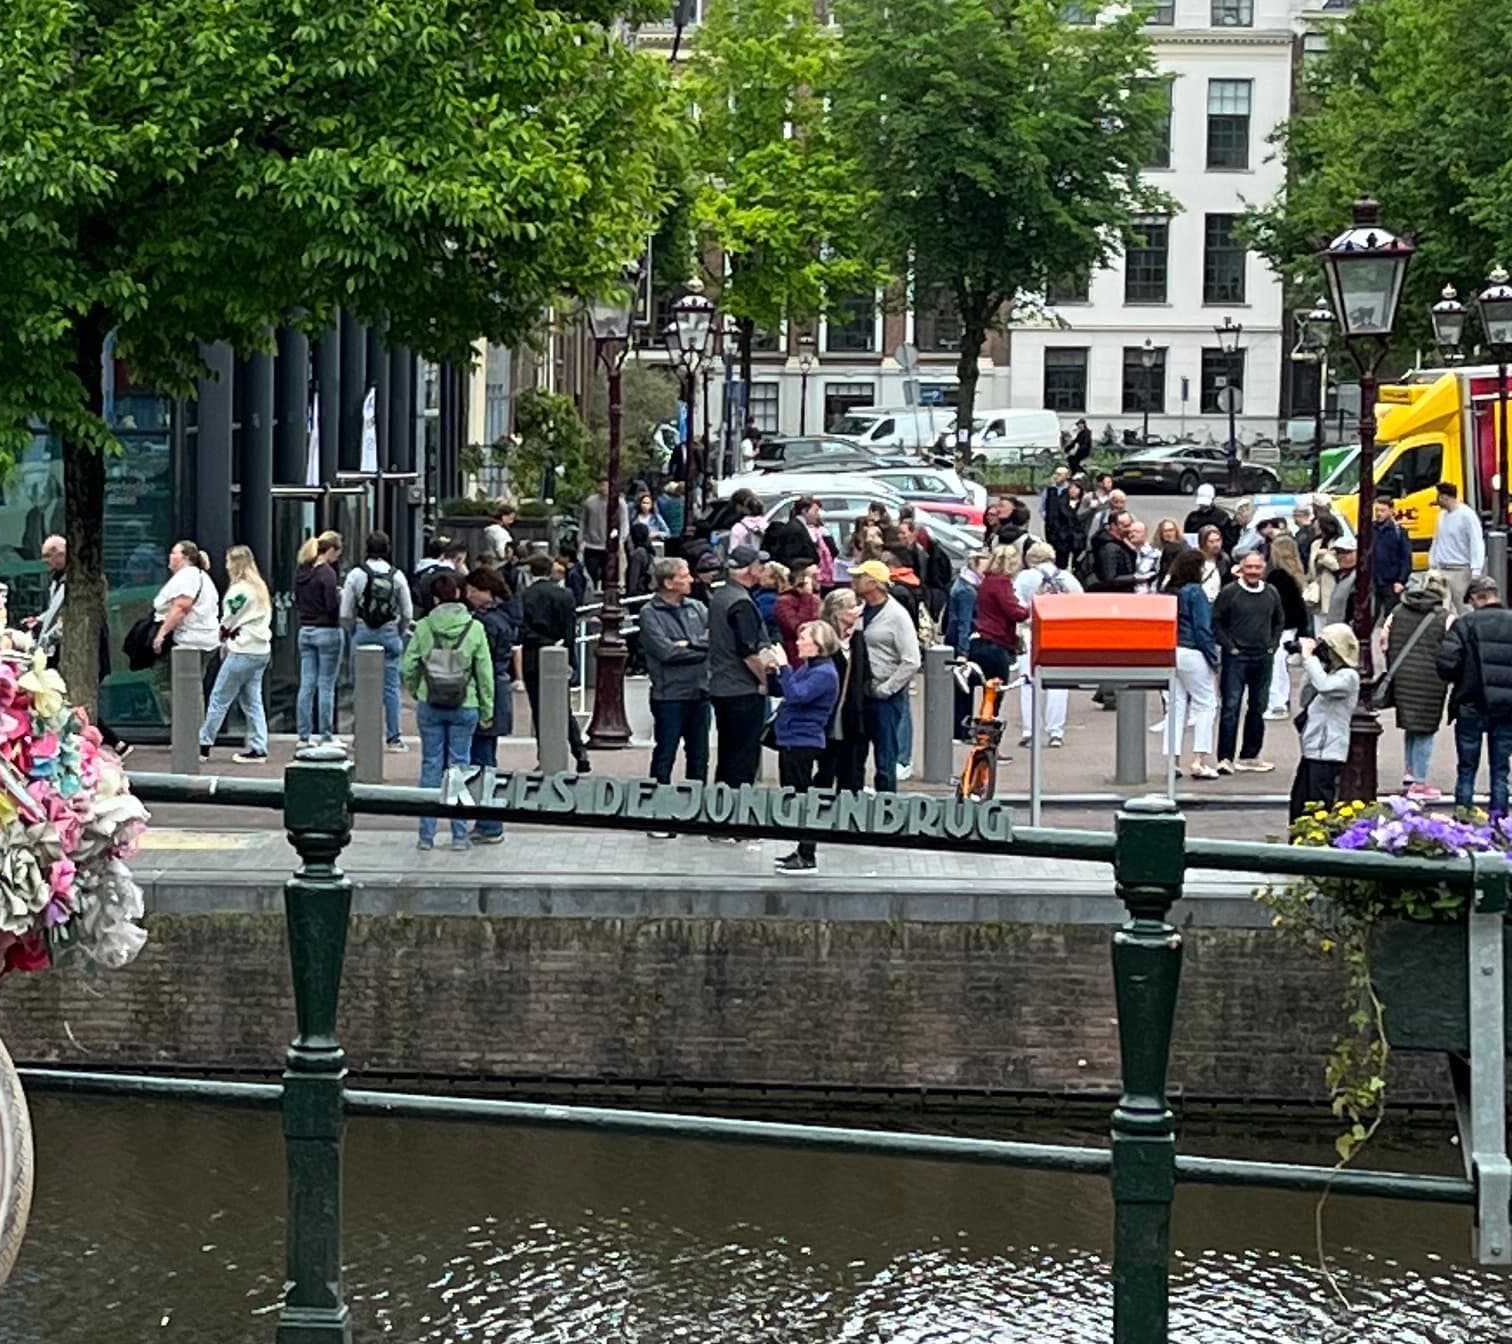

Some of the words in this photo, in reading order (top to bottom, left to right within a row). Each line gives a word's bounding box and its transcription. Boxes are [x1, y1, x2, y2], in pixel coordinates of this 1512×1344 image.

[445, 765, 577, 813] KEES
[593, 775, 658, 818] DE
[672, 779, 1013, 842] JONGENBRUG
